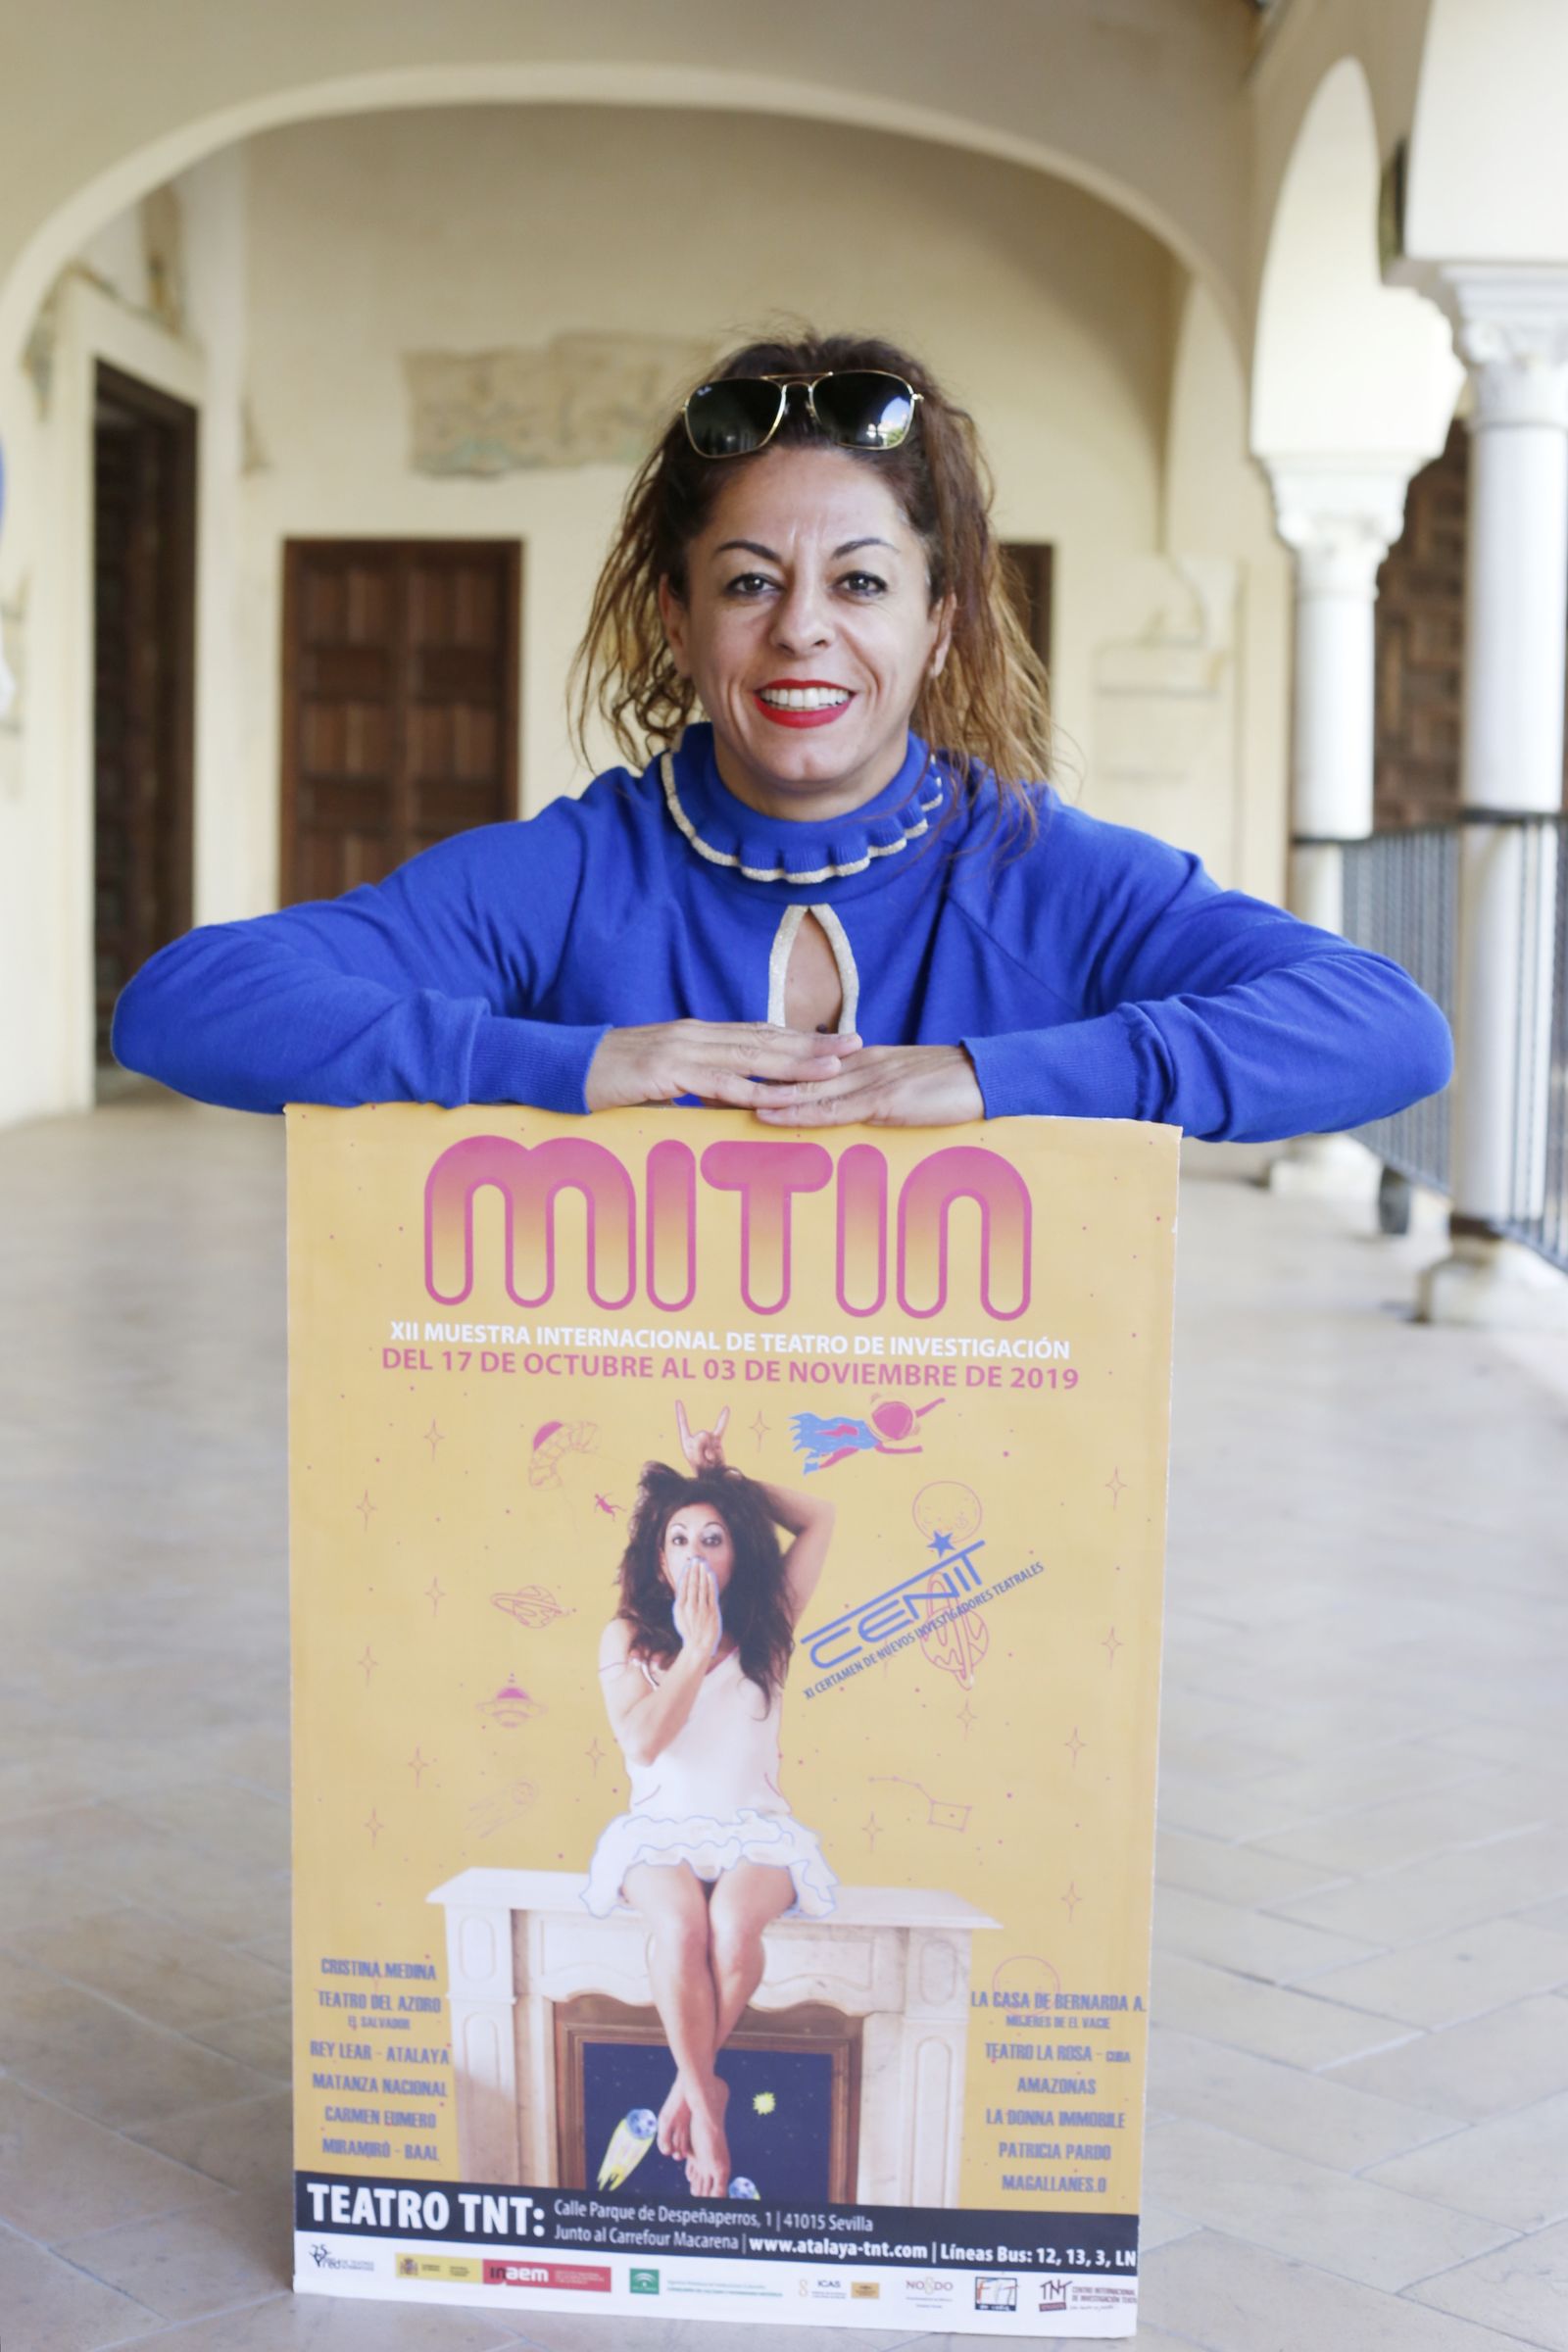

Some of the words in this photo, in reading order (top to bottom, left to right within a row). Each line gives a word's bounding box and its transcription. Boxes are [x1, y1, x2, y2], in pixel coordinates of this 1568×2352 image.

[390, 1321, 418, 1342] XII
[424, 1323, 531, 1345] MUESTRA
[538, 1327, 720, 1349] INTERNACIONAL
[726, 1332, 757, 1351] DE
[760, 1333, 848, 1354] TEATRO
[854, 1336, 884, 1355] DE
[890, 1336, 1069, 1359] INVESTIGACIÓN
[382, 1348, 432, 1370] DEL
[442, 1350, 471, 1372] 17
[480, 1351, 515, 1373] DE
[523, 1353, 654, 1378] OCTUBRE
[662, 1357, 696, 1379] AL
[704, 1358, 735, 1380] 03
[745, 1359, 781, 1382] DE
[789, 1361, 956, 1387] NOVIEMBRE
[965, 1365, 1003, 1388] DE
[1010, 1367, 1079, 1390] 2019
[800, 1540, 985, 1669] CENIT
[803, 1687, 815, 1700] XI
[814, 1661, 863, 1693] CERTAMEN
[862, 1653, 877, 1667] DE
[877, 1633, 915, 1660] NUEVOS
[914, 1590, 994, 1639] INVESTIGADORES
[992, 1562, 1045, 1595] TEATRALES
[320, 1958, 380, 1978] CRISTINA
[385, 1962, 437, 1981] MEDINA
[318, 1990, 367, 2009] TEATRO
[370, 1994, 392, 2011] DEL
[971, 1991, 988, 2007] LA
[993, 1991, 1029, 2008] CASA
[1035, 1993, 1051, 2009] DE
[1054, 1994, 1128, 2011] BERNARDA
[361, 2017, 411, 2031] SALVADOR
[1005, 2016, 1052, 2028] MUJERES
[1054, 2017, 1065, 2029] DE
[310, 2040, 335, 2057] REY
[339, 2043, 371, 2060] LEAR
[386, 2046, 450, 2065] ATALAYA
[985, 2042, 1033, 2060] TEATRO
[1037, 2045, 1054, 2061] LA
[1057, 2045, 1093, 2062] ROSA
[313, 2073, 378, 2093] MATANZA
[383, 2079, 448, 2097] NACIONAL
[1017, 2077, 1097, 2094] AMAZONAS
[324, 2106, 379, 2125] CARMEN
[986, 2109, 1004, 2125] LA
[1007, 2110, 1054, 2126] DONNA
[405, 2144, 440, 2161] BAAL
[999, 2142, 1061, 2159] PATRICIA
[1065, 2143, 1111, 2161] PARDO
[307, 2182, 450, 2230] TEATRO
[458, 2193, 545, 2237] TNT:
[554, 2199, 586, 2217] Calle
[589, 2201, 636, 2222] Parque
[638, 2205, 656, 2222] de
[658, 2205, 761, 2229] Despeñaperros,
[765, 2212, 772, 2227] 1
[783, 2213, 825, 2230] 41015
[828, 2214, 873, 2231] Sevilla
[554, 2225, 591, 2241] Junto
[594, 2227, 607, 2242] al
[609, 2227, 670, 2246] Carrefour
[673, 2230, 739, 2250] Macarena
[749, 2237, 928, 2260] www.atalaya-tnt.com
[941, 2243, 993, 2262] Líneas
[997, 2245, 1032, 2263] Bus:
[1036, 2248, 1061, 2266] 12,
[1066, 2249, 1091, 2267] 13,
[1096, 2250, 1110, 2268] 3,
[1115, 2250, 1137, 2267] LN
[490, 2266, 549, 2282] inaem
